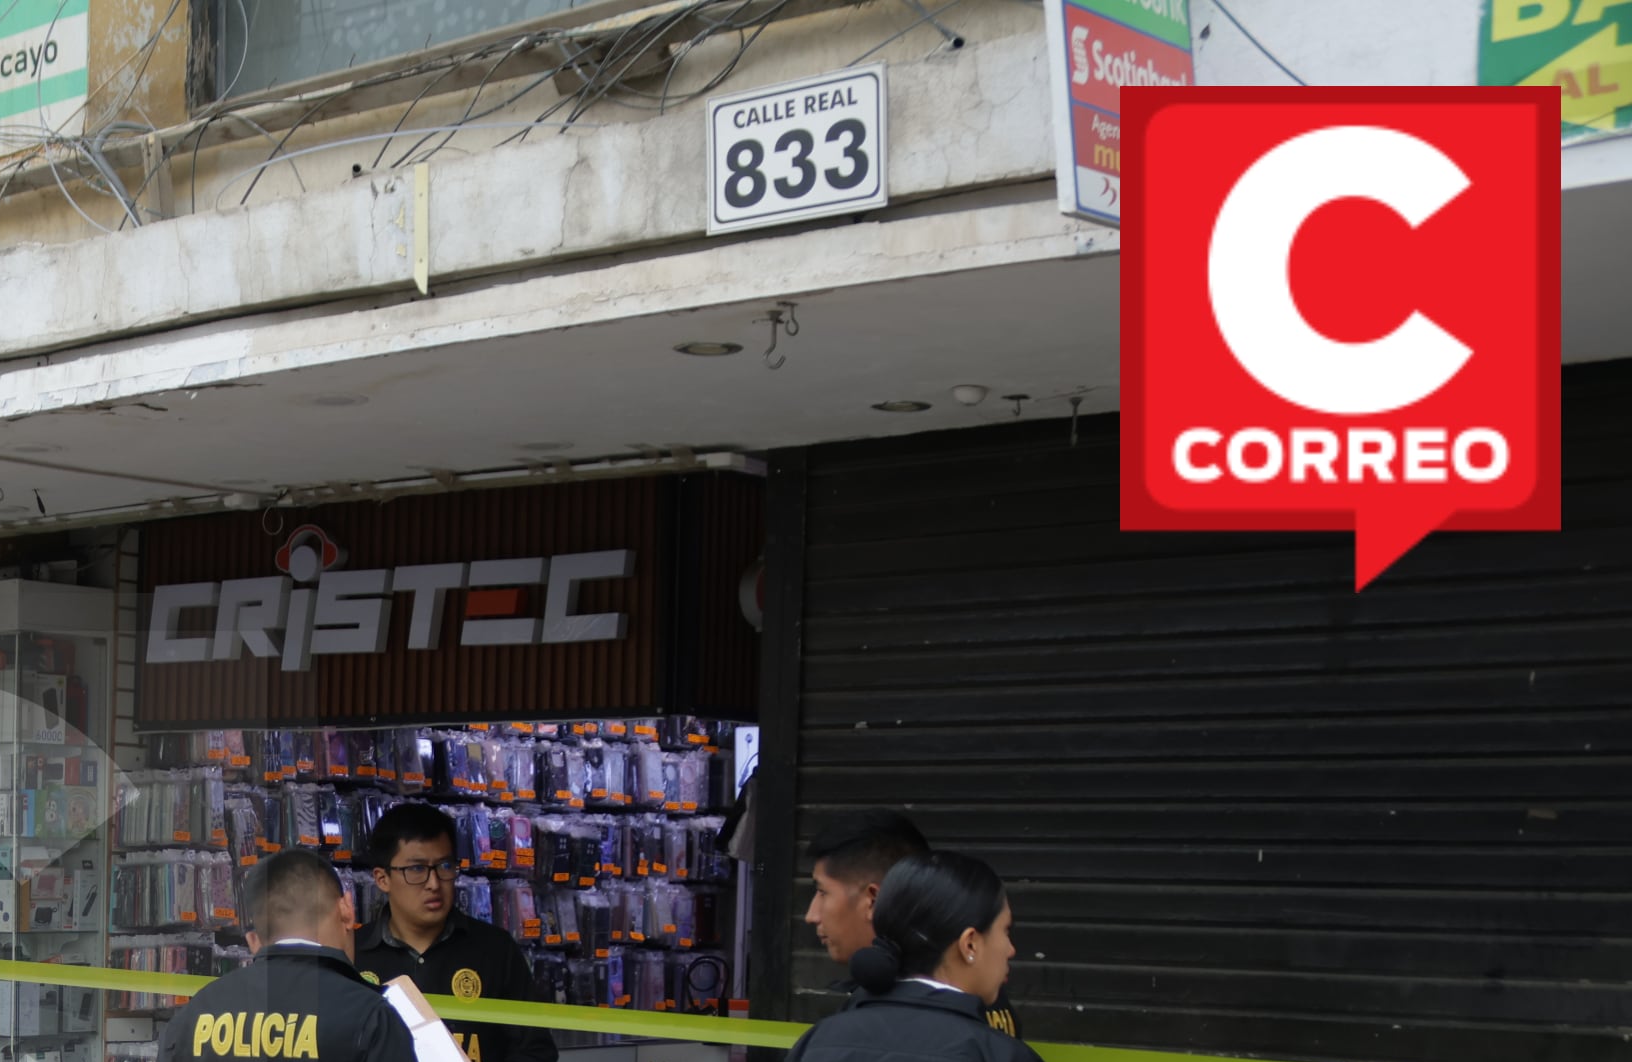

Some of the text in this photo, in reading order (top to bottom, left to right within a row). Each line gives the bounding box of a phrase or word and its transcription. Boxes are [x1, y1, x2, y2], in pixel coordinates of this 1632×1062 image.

[733, 87, 858, 129] CALLE REAL
[724, 118, 869, 208] 833
